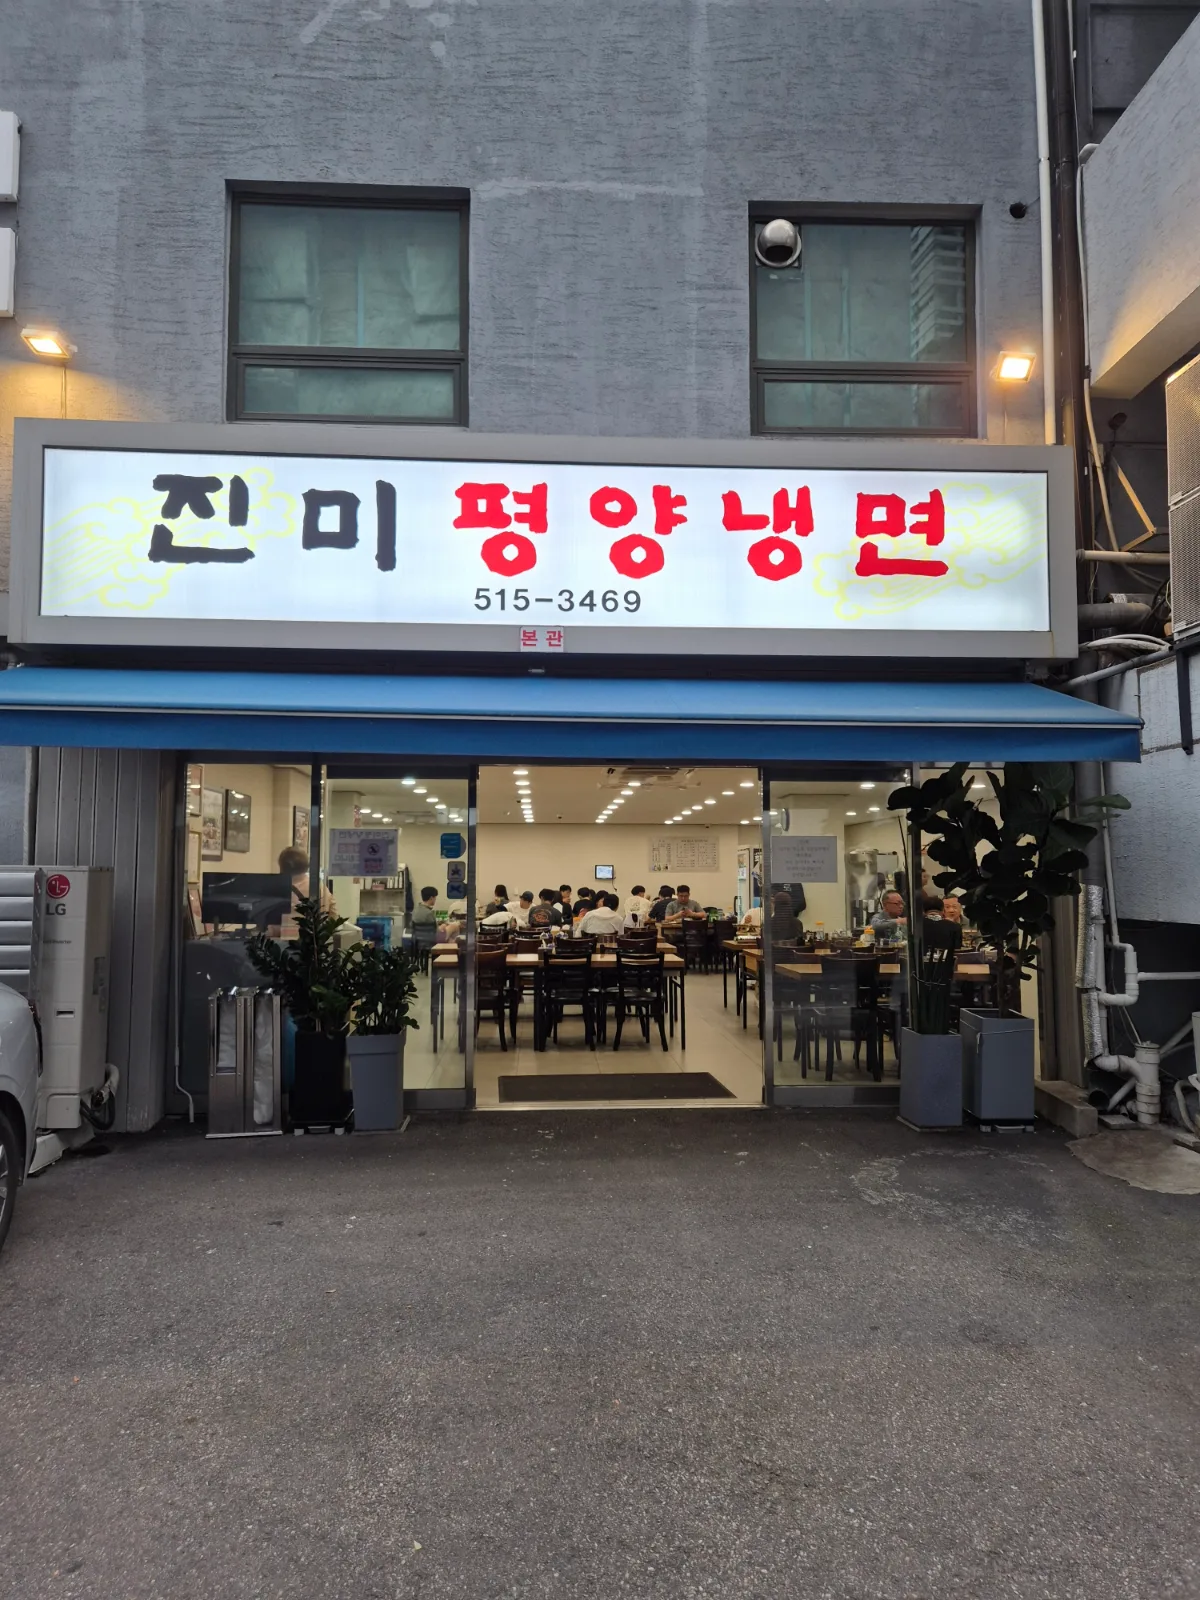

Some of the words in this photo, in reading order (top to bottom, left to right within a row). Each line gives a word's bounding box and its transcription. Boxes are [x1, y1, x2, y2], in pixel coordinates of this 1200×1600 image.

[148, 474, 396, 572] 진미
[453, 482, 949, 582] 평양냉면
[475, 588, 641, 613] 515-3469
[45, 903, 66, 916] LG
